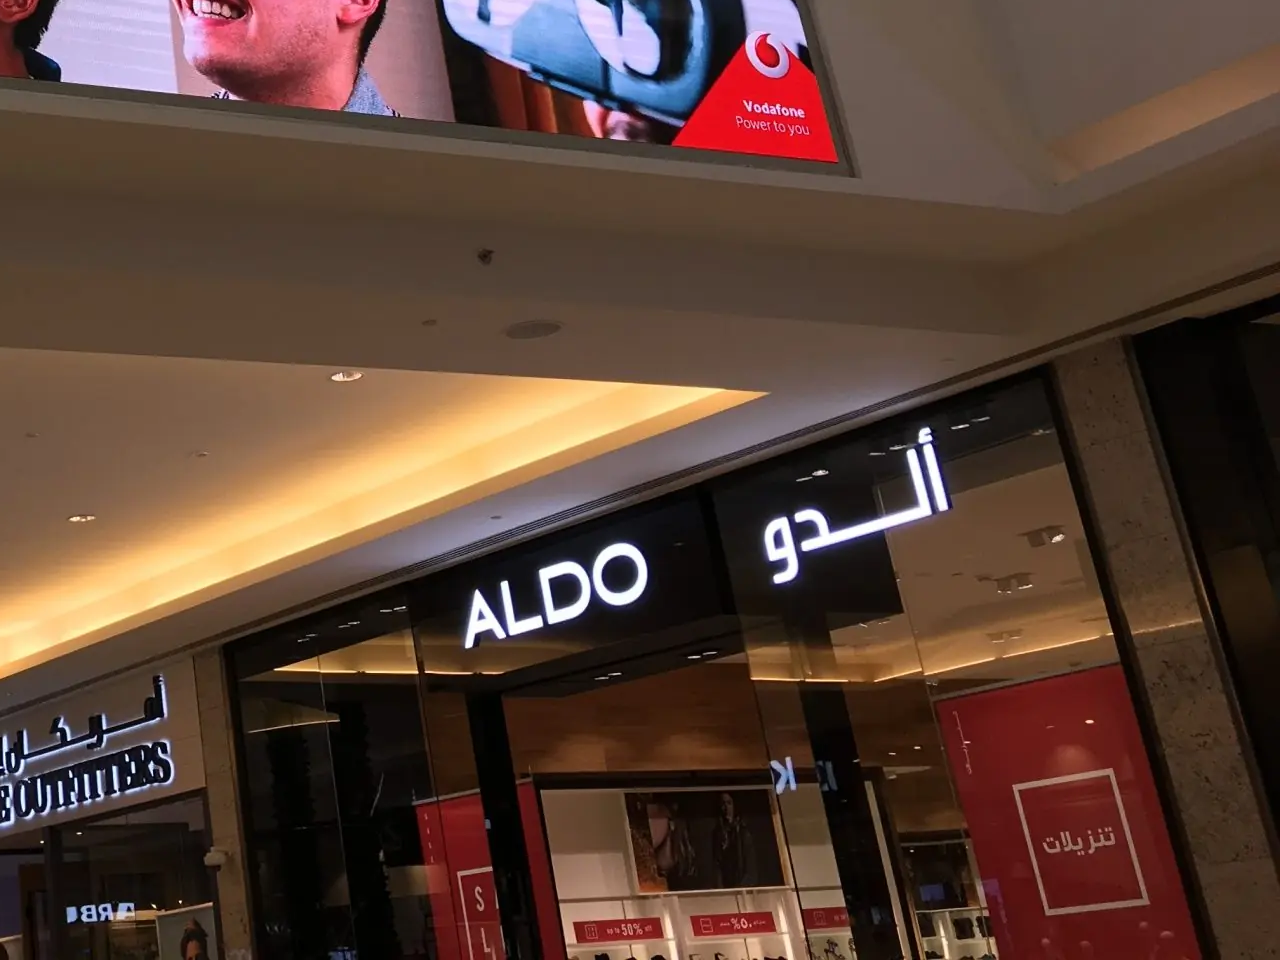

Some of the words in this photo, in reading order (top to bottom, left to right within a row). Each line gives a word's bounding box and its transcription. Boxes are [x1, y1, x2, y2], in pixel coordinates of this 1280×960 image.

[742, 99, 806, 118] Vodafone
[735, 115, 771, 131] Power
[773, 120, 786, 132] to
[787, 124, 810, 136] you
[763, 426, 949, 586] ألدو
[464, 541, 649, 650] ALDO
[13, 740, 175, 820] OUTFITTERS
[1041, 826, 1117, 856] تنزيلات
[621, 923, 644, 936] 50%
